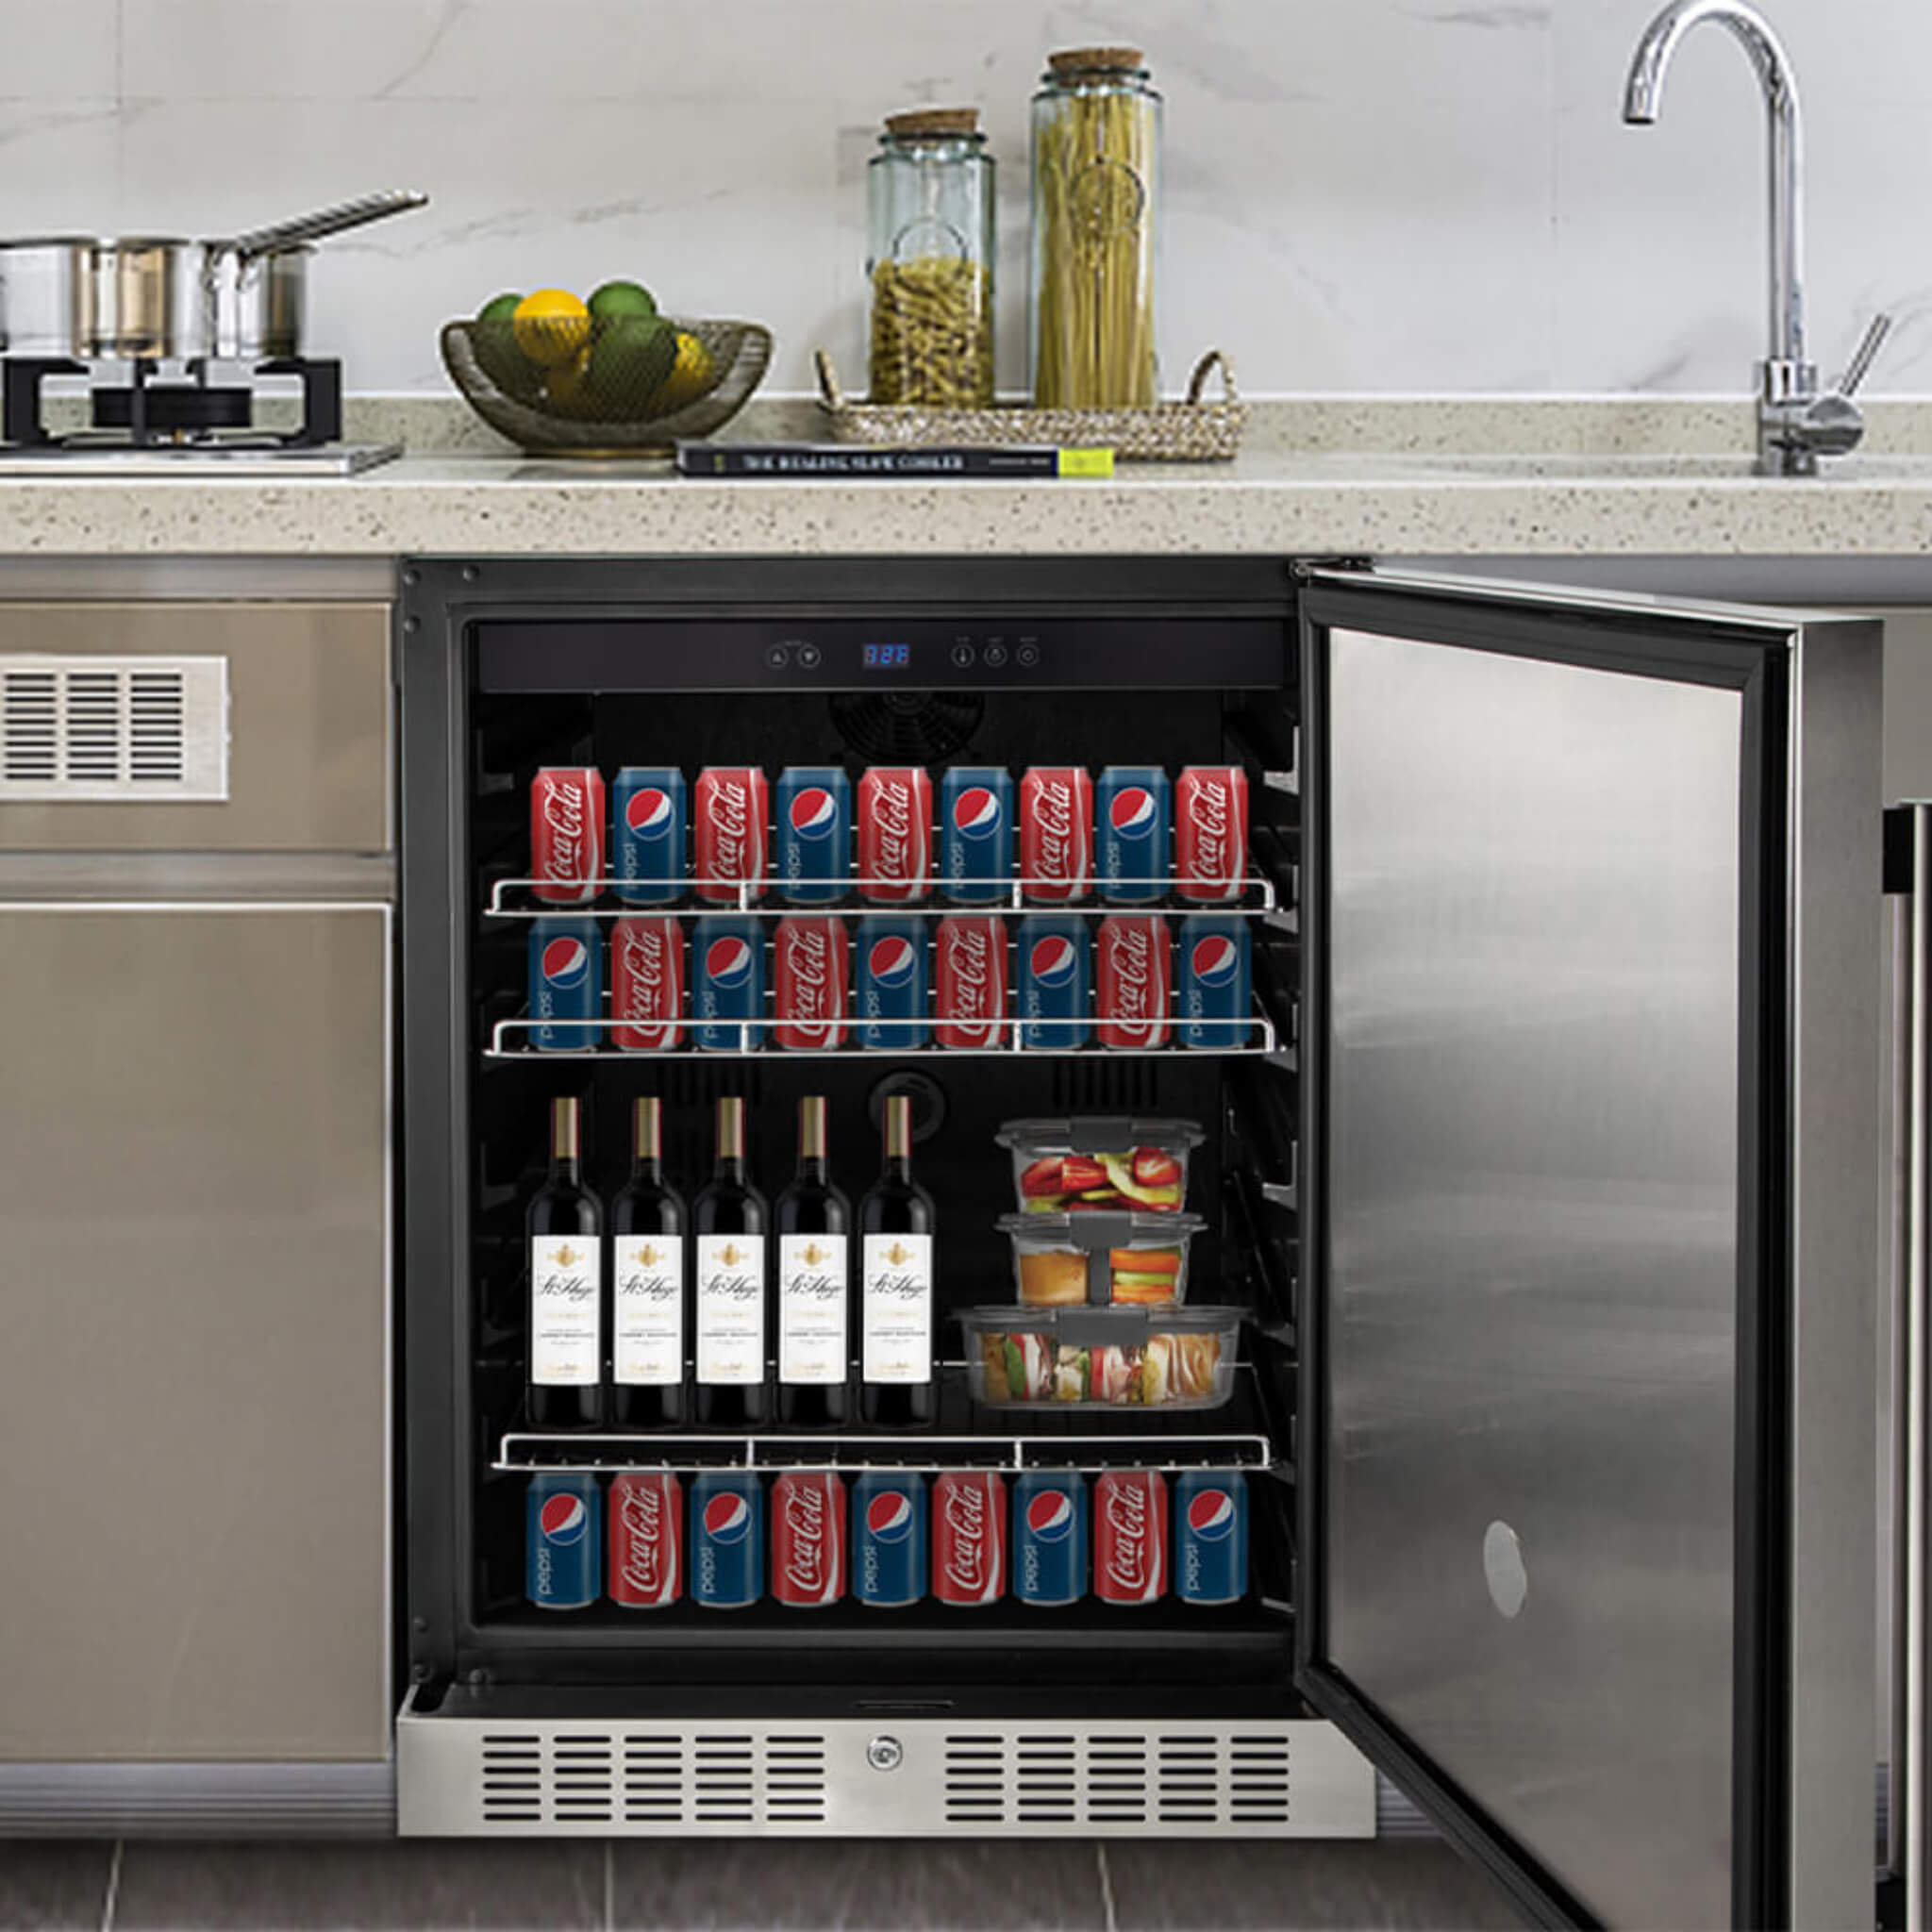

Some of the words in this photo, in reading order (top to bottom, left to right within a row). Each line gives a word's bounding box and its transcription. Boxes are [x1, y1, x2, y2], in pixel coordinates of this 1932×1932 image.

[538, 991, 555, 1039] ppsi
[702, 991, 719, 1039] ppsi
[866, 991, 883, 1038] ppsi
[1026, 990, 1043, 1038] ppsi
[1188, 990, 1205, 1037] ppsi
[537, 1547, 554, 1594] pepsi
[699, 1546, 716, 1593] pepsi
[864, 1545, 881, 1592] pepsi
[1024, 1544, 1041, 1591] pepsi
[1185, 1543, 1202, 1591] pepsi
